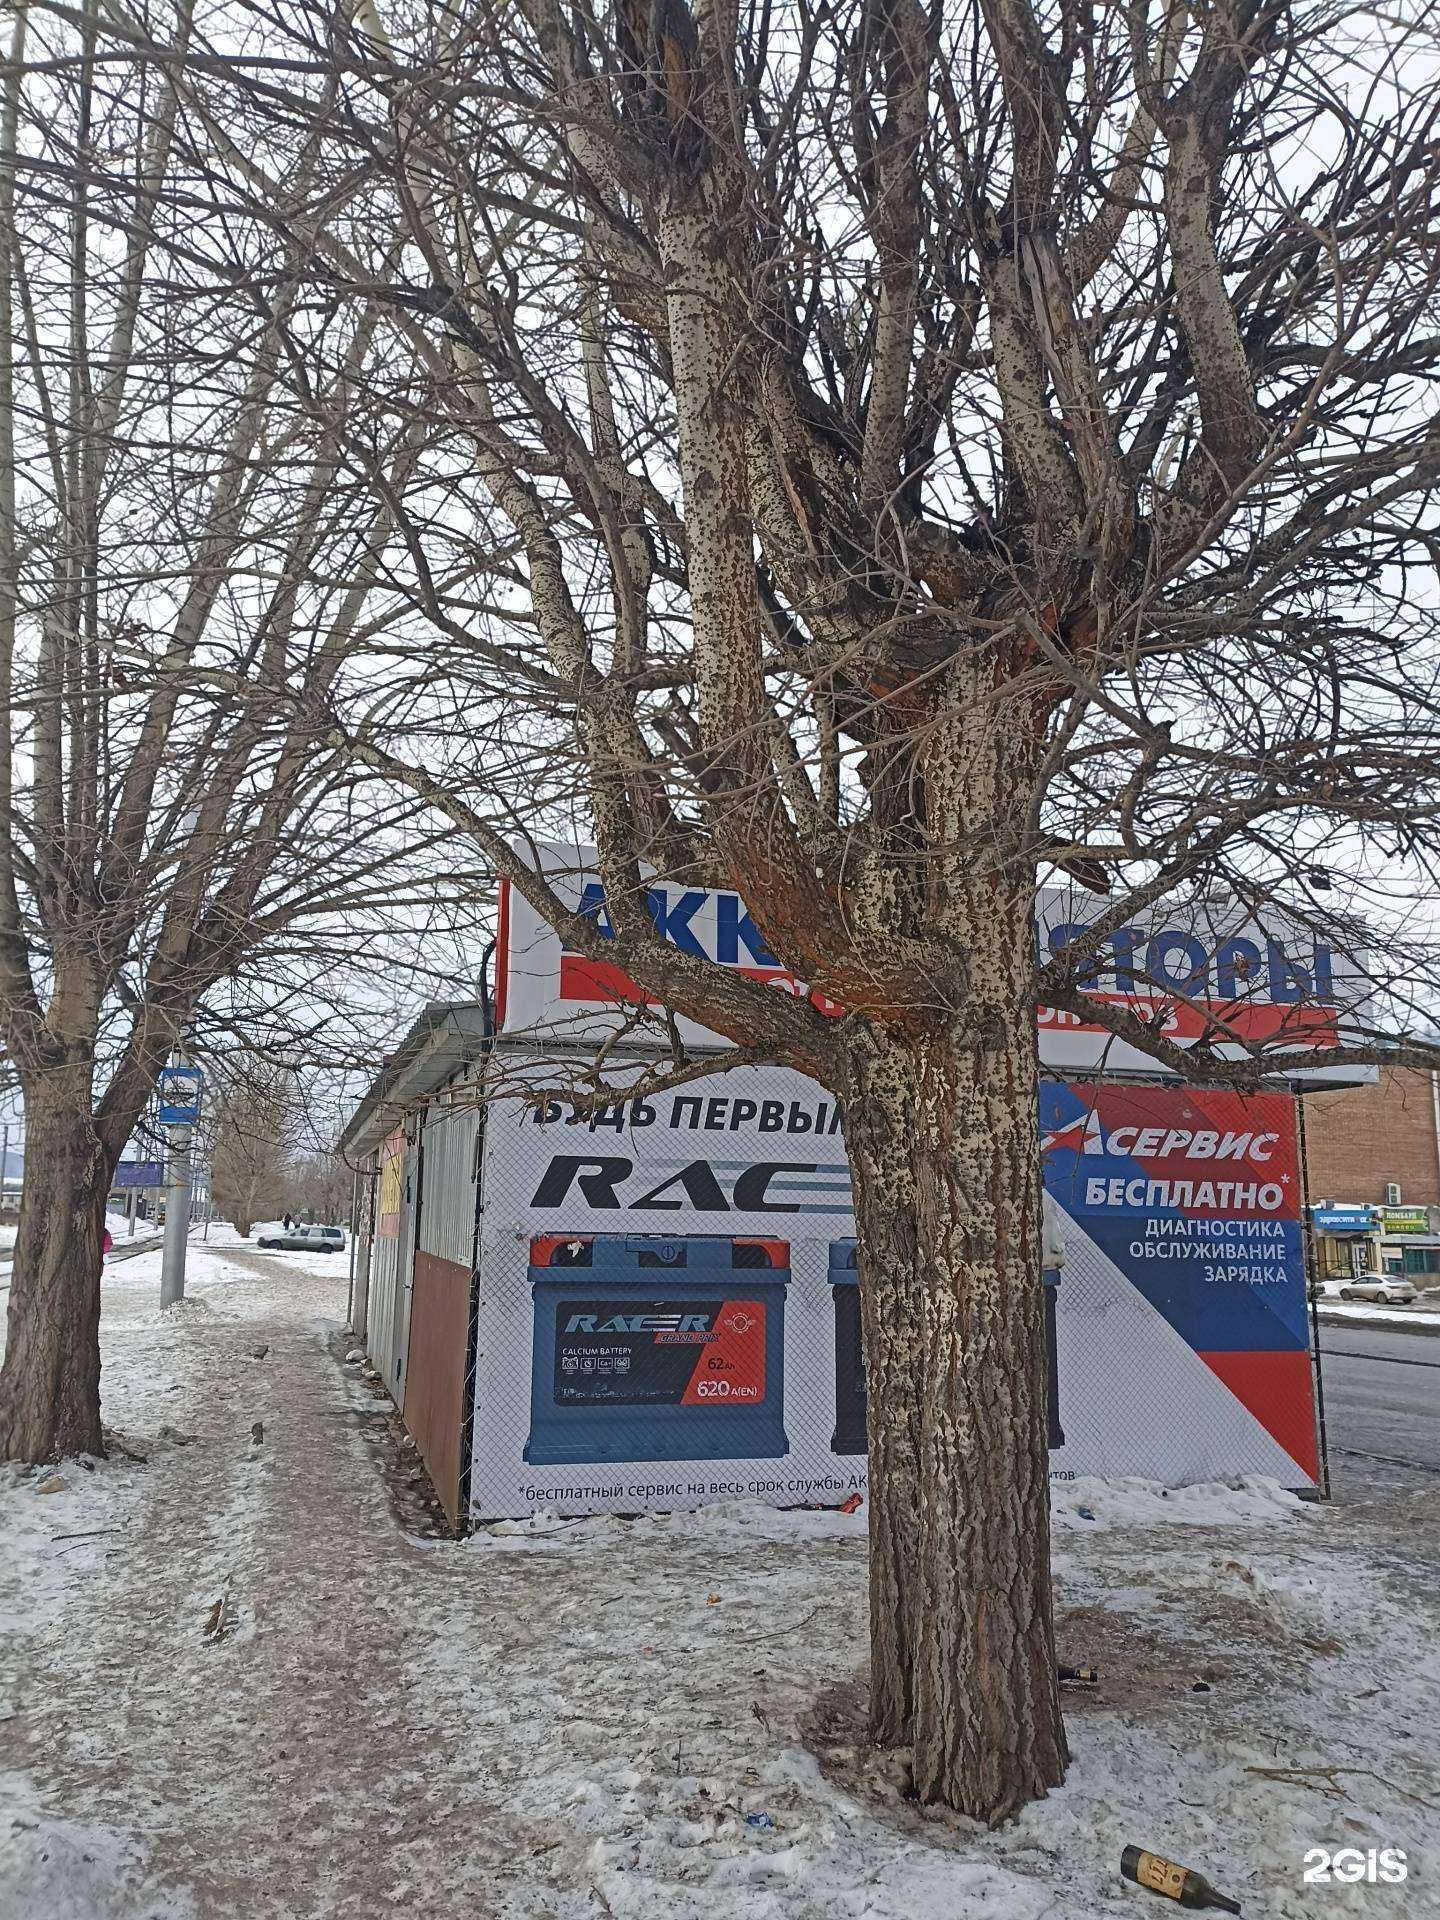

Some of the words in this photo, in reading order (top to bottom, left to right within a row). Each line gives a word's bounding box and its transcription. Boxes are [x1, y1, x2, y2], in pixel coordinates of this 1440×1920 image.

[1145, 1219, 1286, 1238] ДИАГНОСТИКА
[1129, 1241, 1287, 1261] ОБСЛУЖИВАНИЕ
[1204, 1265, 1289, 1285] ЗАРЯДКА
[562, 1347, 598, 1356] CALCIUM
[600, 1347, 632, 1356] BATTERY
[628, 1483, 683, 1499] сервис
[687, 1483, 705, 1494] на
[709, 1481, 744, 1494] весь
[748, 1479, 784, 1495] срок
[787, 1474, 844, 1494] службы
